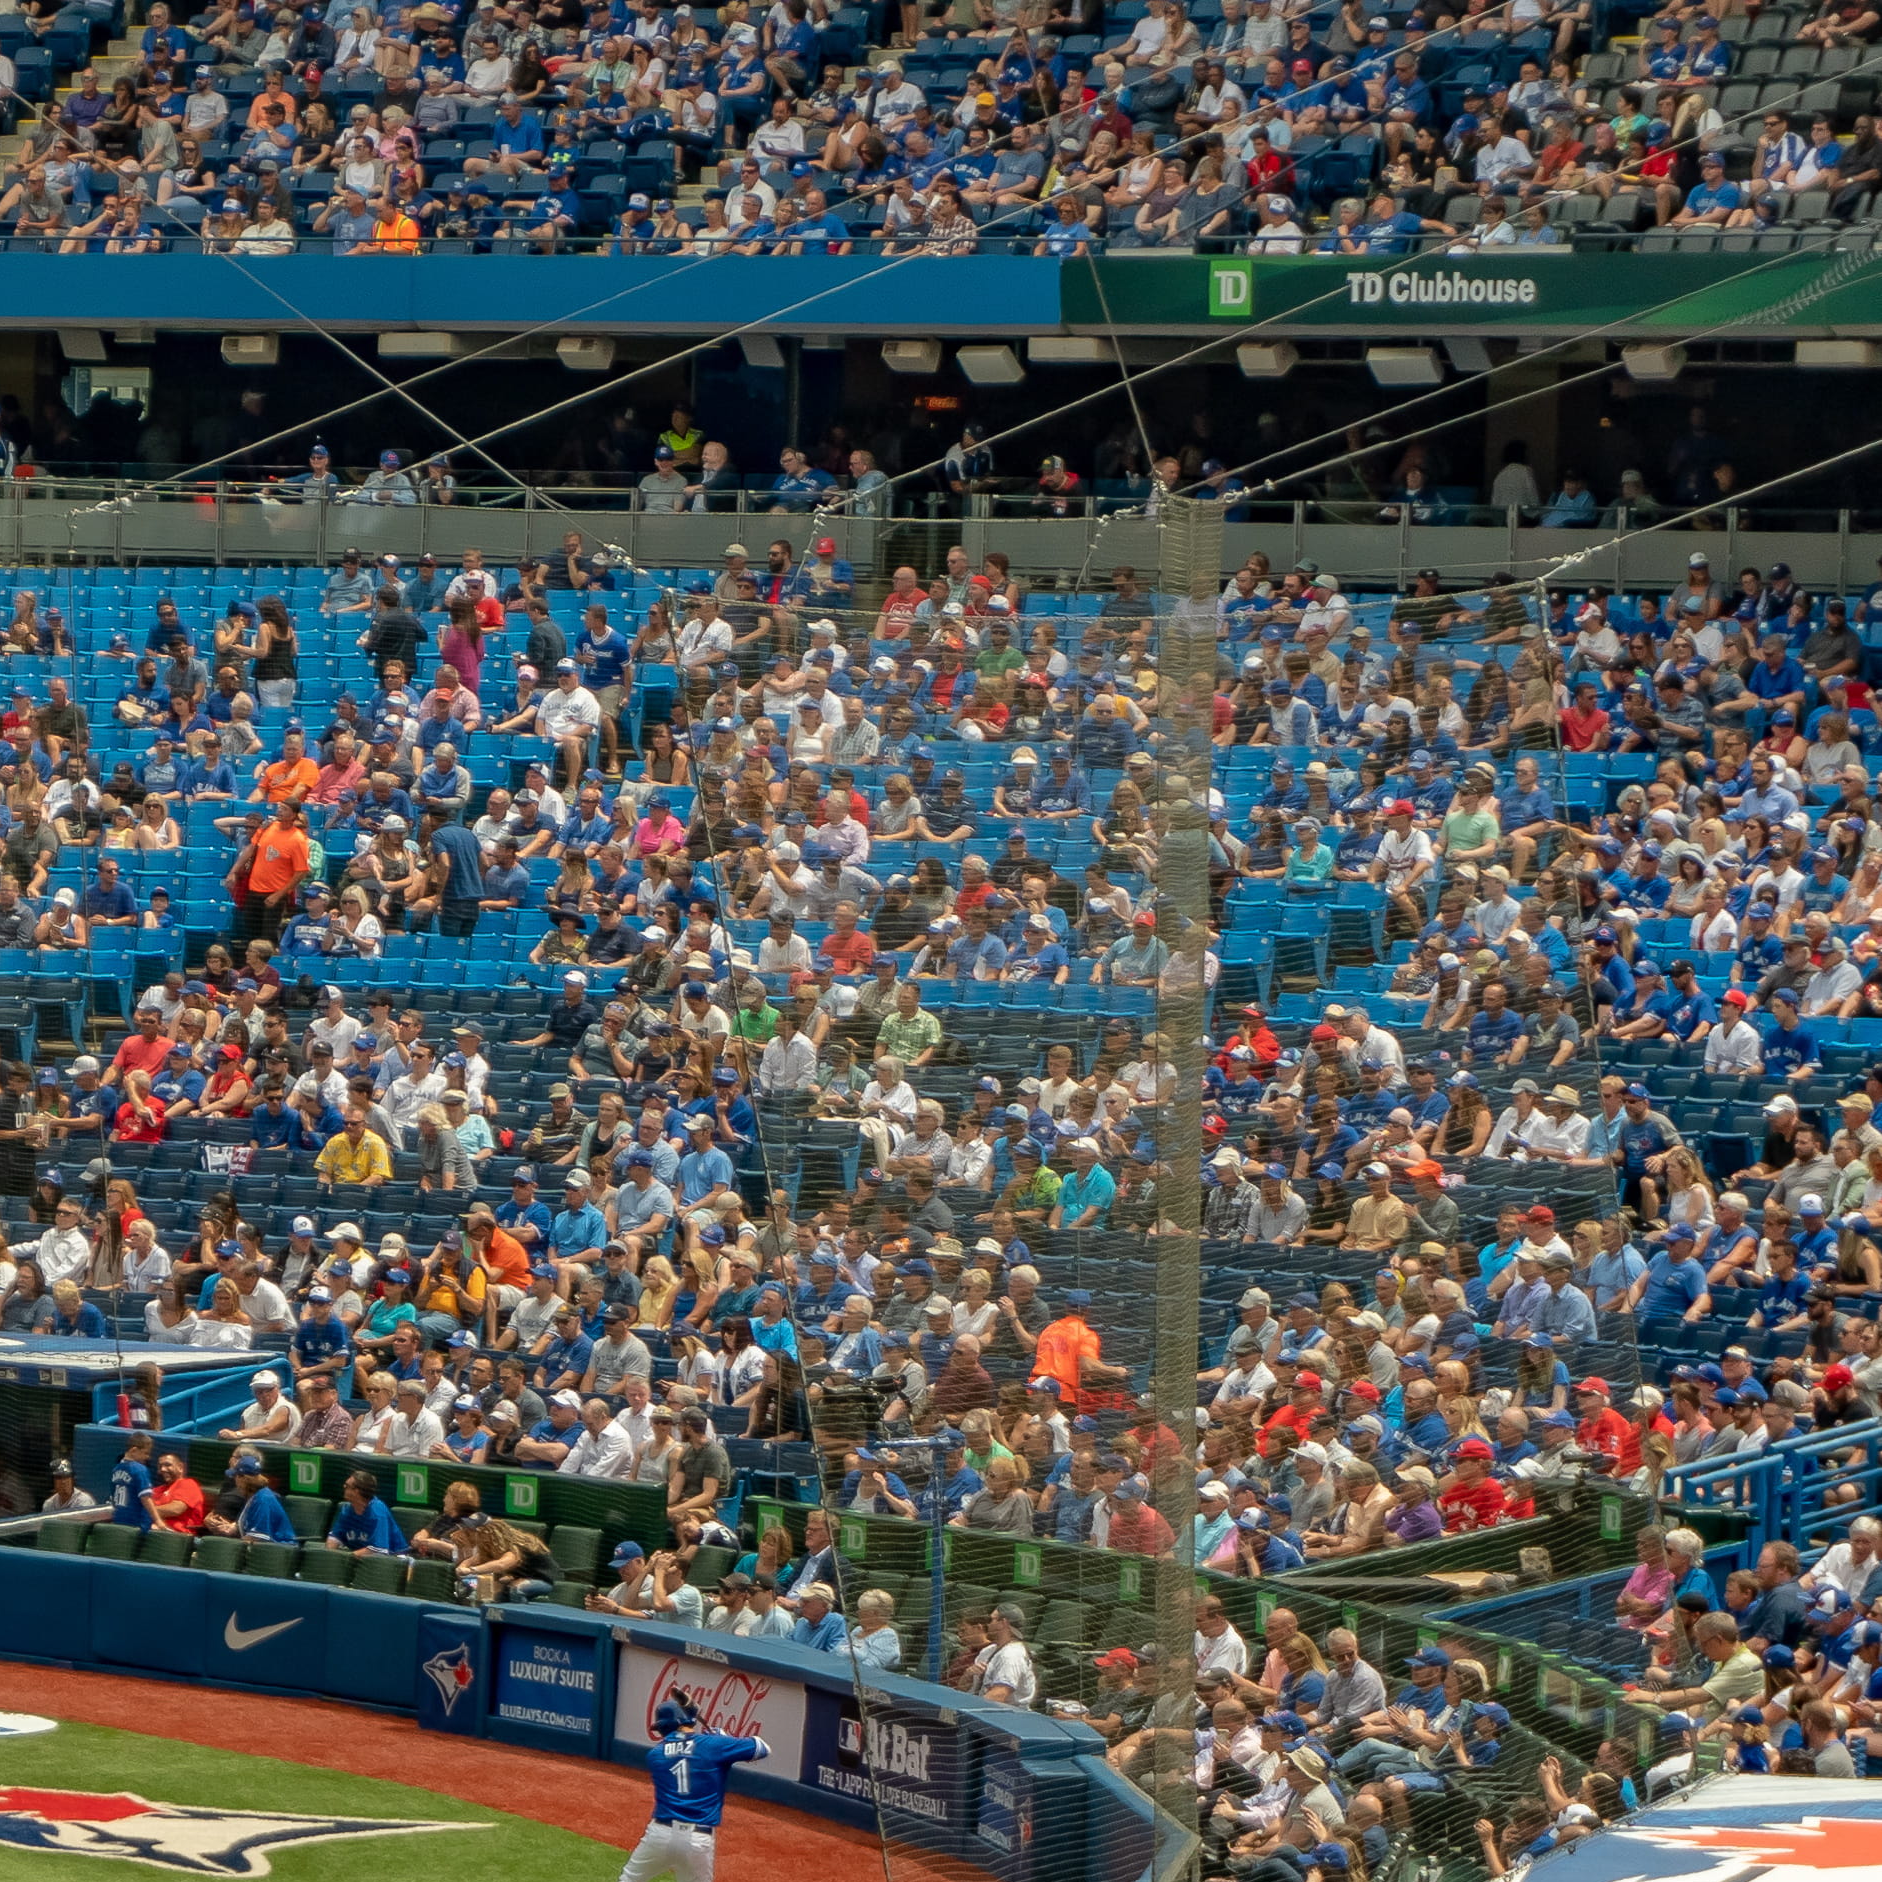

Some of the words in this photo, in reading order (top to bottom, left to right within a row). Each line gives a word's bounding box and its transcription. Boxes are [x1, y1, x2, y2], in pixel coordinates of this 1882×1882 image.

[1214, 270, 1247, 305] TD
[1347, 272, 1383, 303] TD
[1387, 272, 1536, 304] Clubhouse
[294, 1461, 317, 1484] TD
[401, 1470, 424, 1495] TD
[509, 1481, 533, 1507] TD
[509, 1660, 556, 1685] LUXURY
[558, 1668, 595, 1692] SUITE
[498, 1703, 591, 1732] BLUEJAYS.COM/SUITE
[663, 1740, 694, 1758] DIAZ
[861, 1717, 890, 1770] At
[890, 1723, 931, 1782] Bat
[668, 1757, 689, 1794] 1
[818, 1764, 836, 1789] THE
[843, 1772, 863, 1796] APP
[882, 1783, 901, 1806] LIVE
[901, 1790, 948, 1820] BASEBALL
